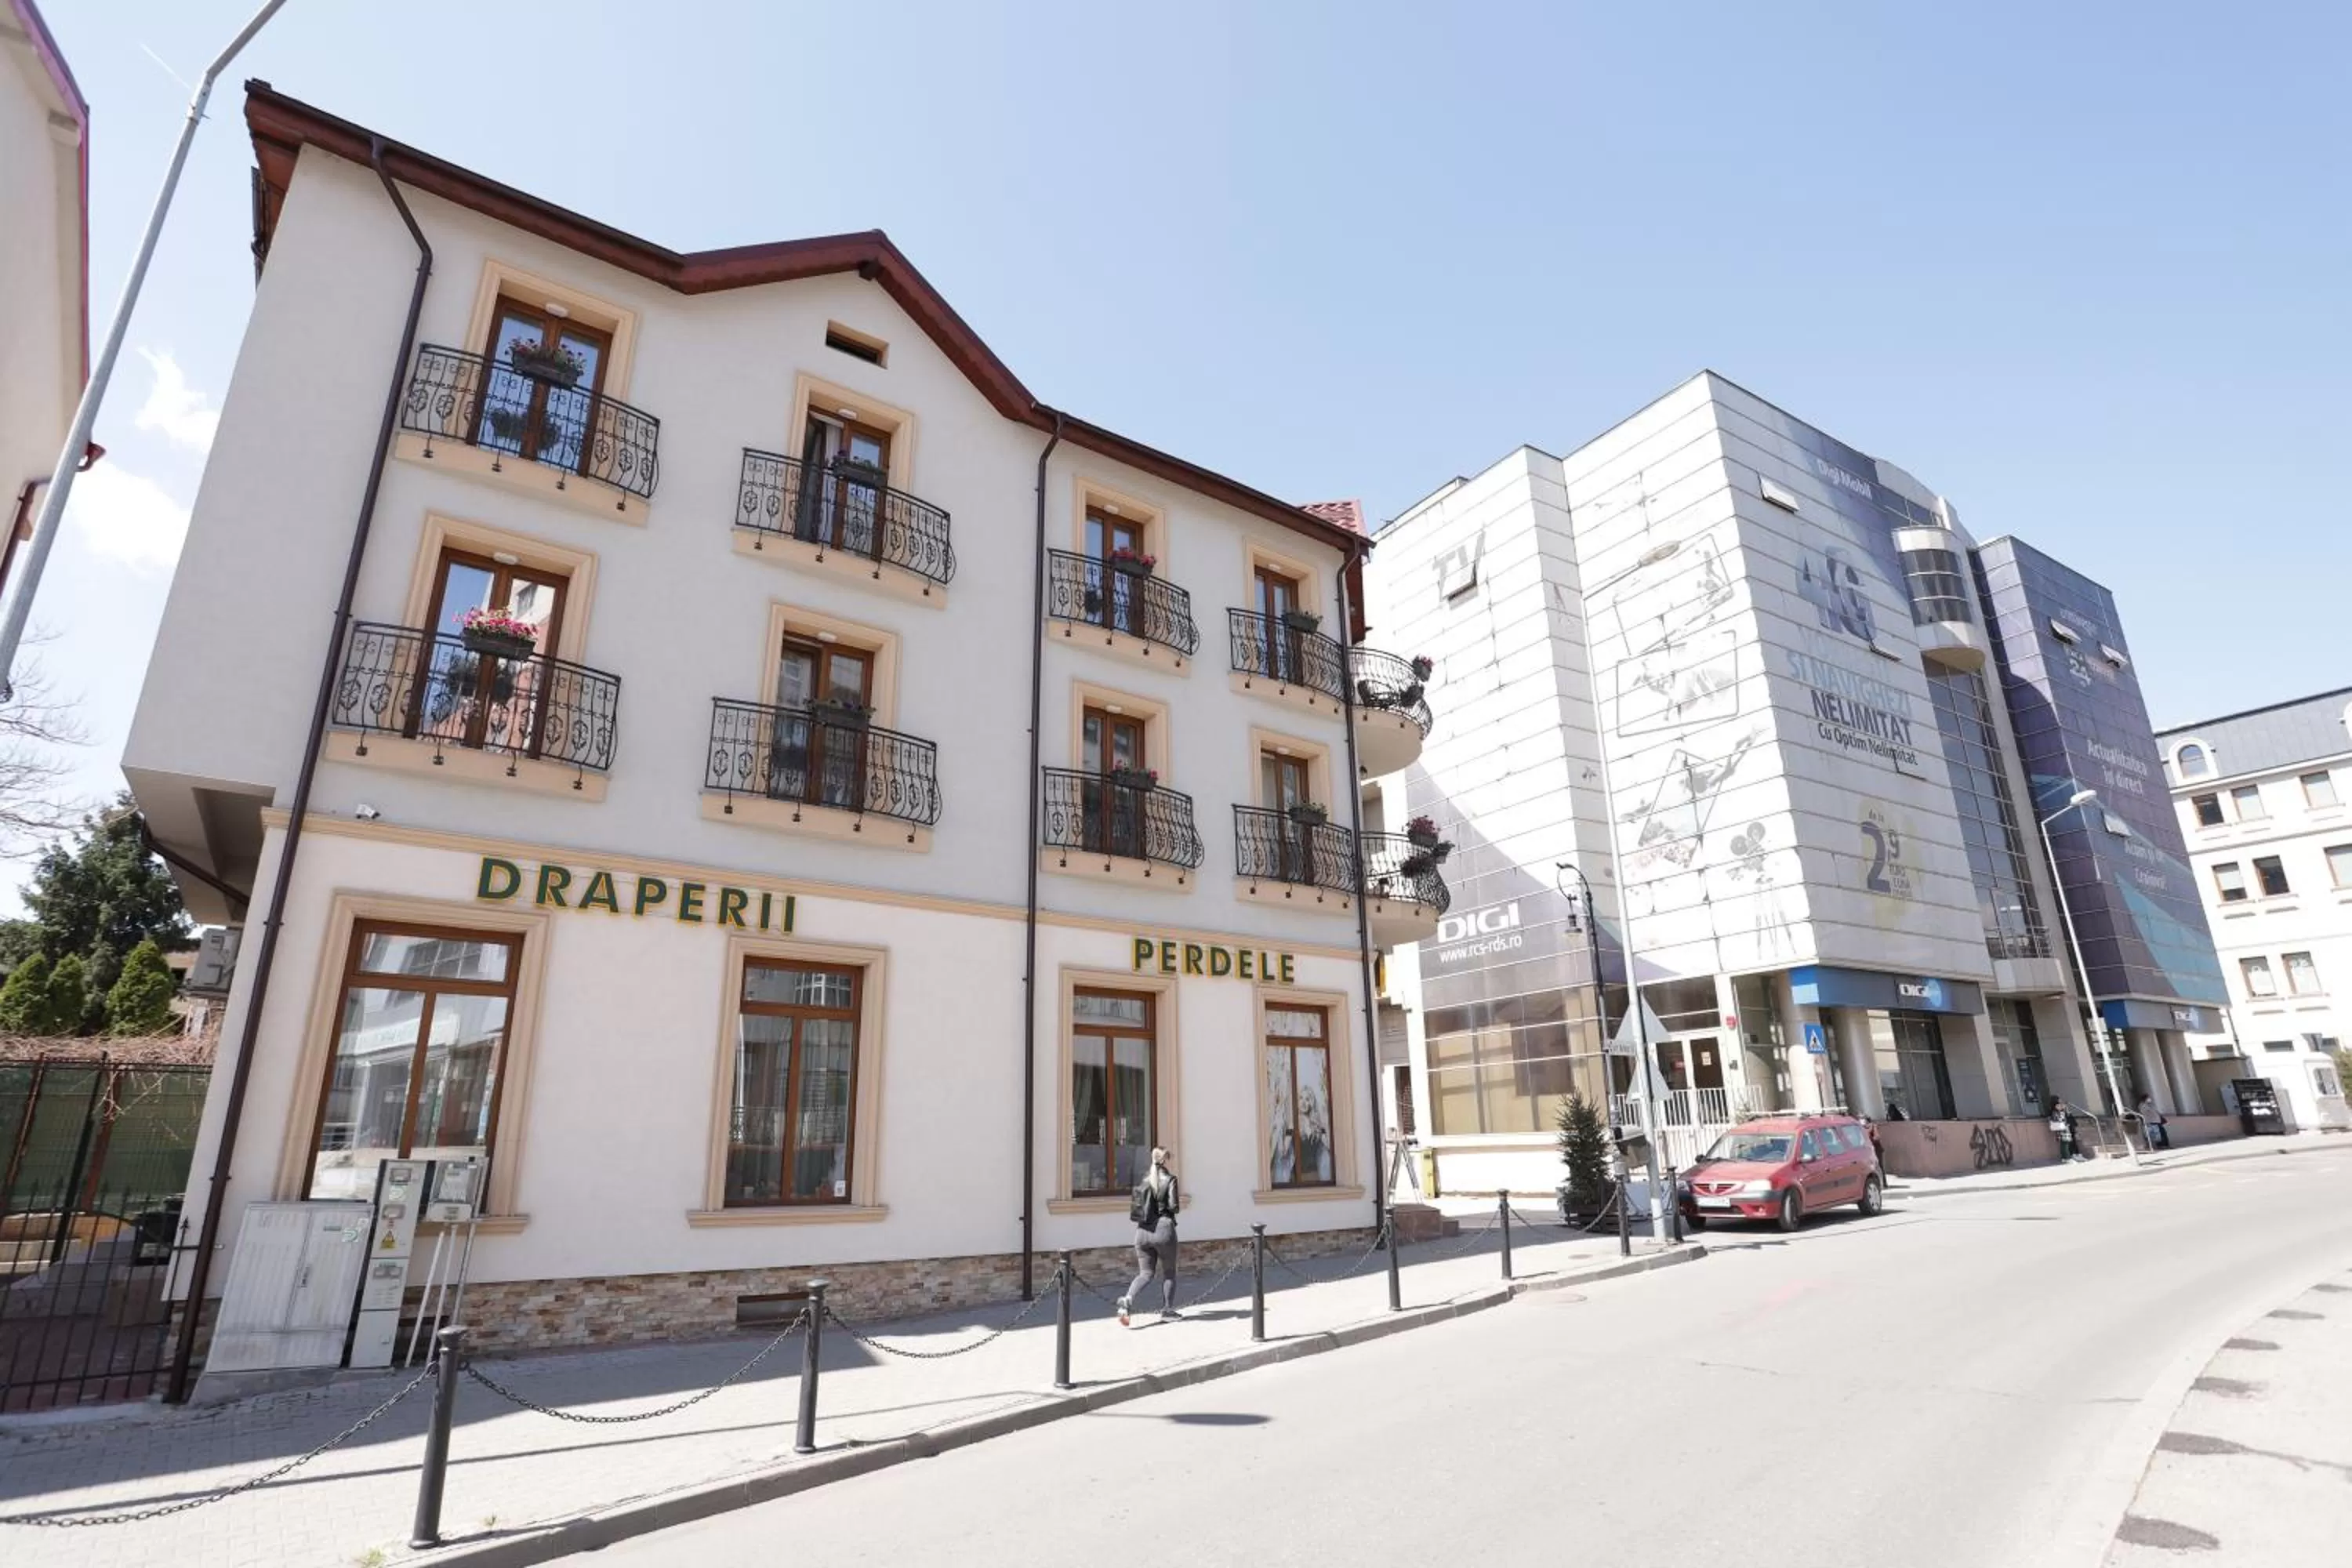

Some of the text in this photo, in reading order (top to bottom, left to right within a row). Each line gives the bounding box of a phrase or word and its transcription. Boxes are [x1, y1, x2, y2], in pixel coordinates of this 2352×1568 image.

[1432, 527, 1486, 603] TV
[1811, 689, 1912, 746] NELIMITAT
[1818, 722, 1832, 741] Cu
[1835, 727, 1867, 753] Optim
[475, 857, 797, 933] DRAPERII
[1437, 902, 1520, 943] DIGI
[1132, 938, 1294, 982] PERDELE
[1439, 935, 1523, 963] www.rcs-rds.ro
